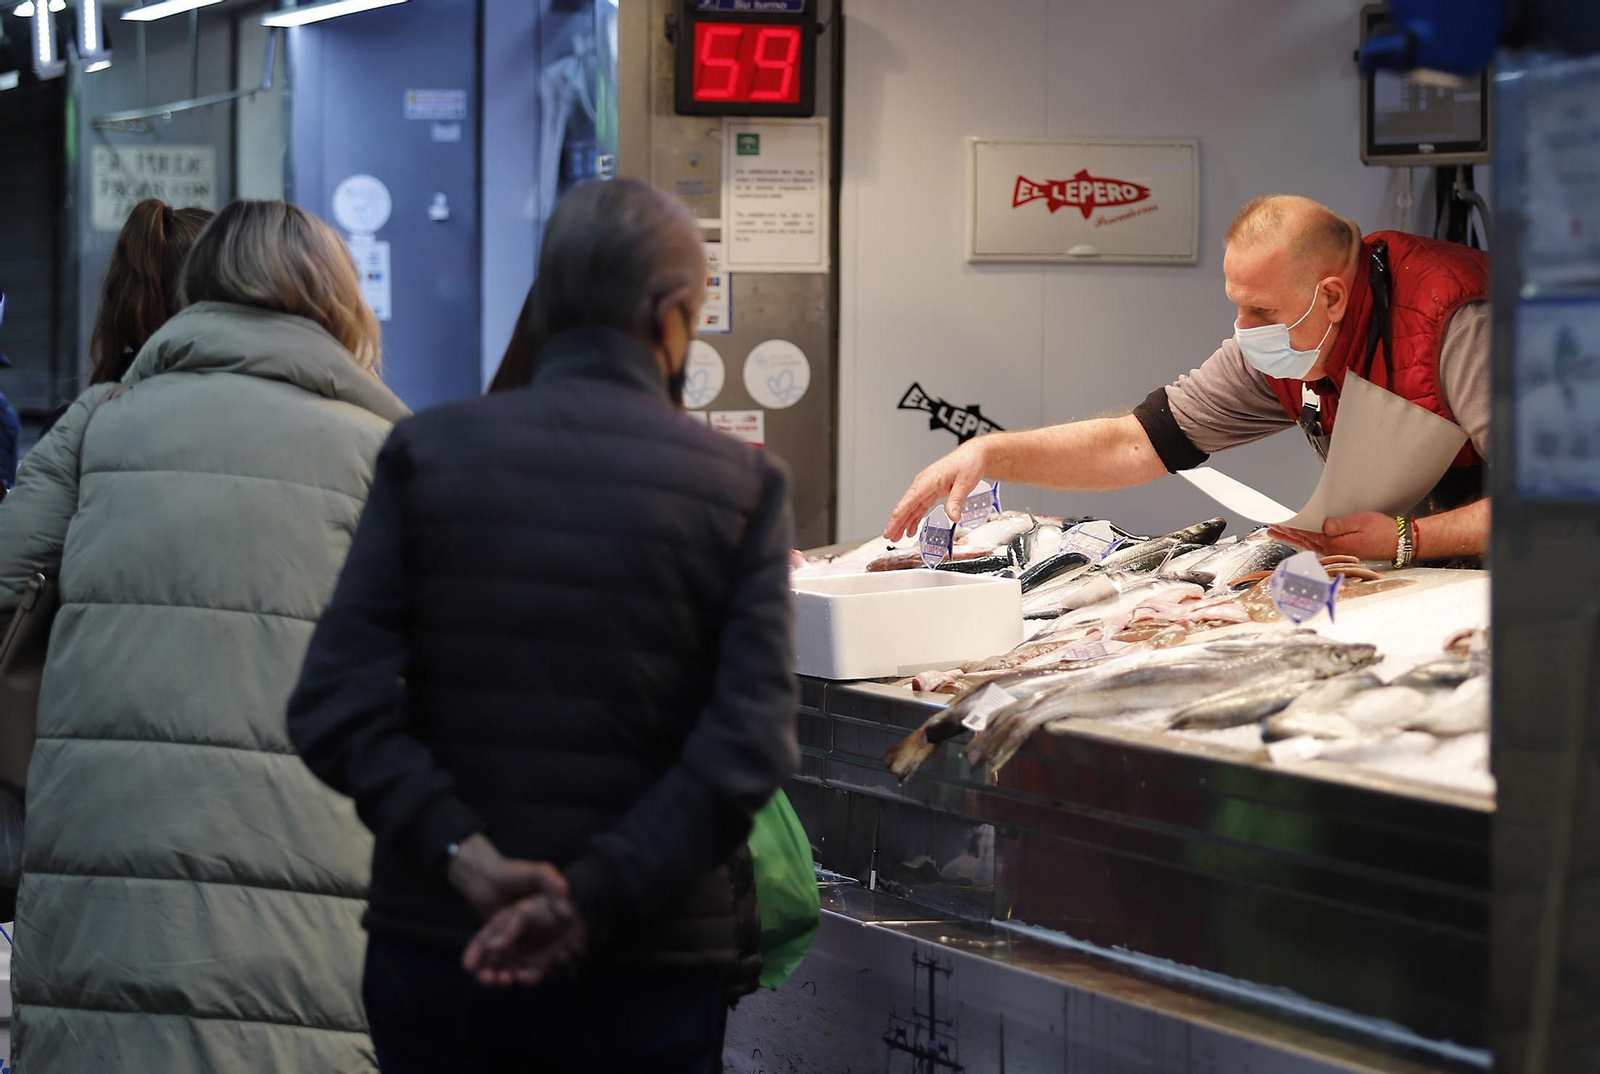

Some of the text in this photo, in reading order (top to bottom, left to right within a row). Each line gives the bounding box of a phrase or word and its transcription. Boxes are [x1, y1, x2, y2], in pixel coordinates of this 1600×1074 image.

[696, 26, 800, 100] 59
[1016, 181, 1139, 204] EL LEPERO
[902, 387, 997, 437] EL LEPE
